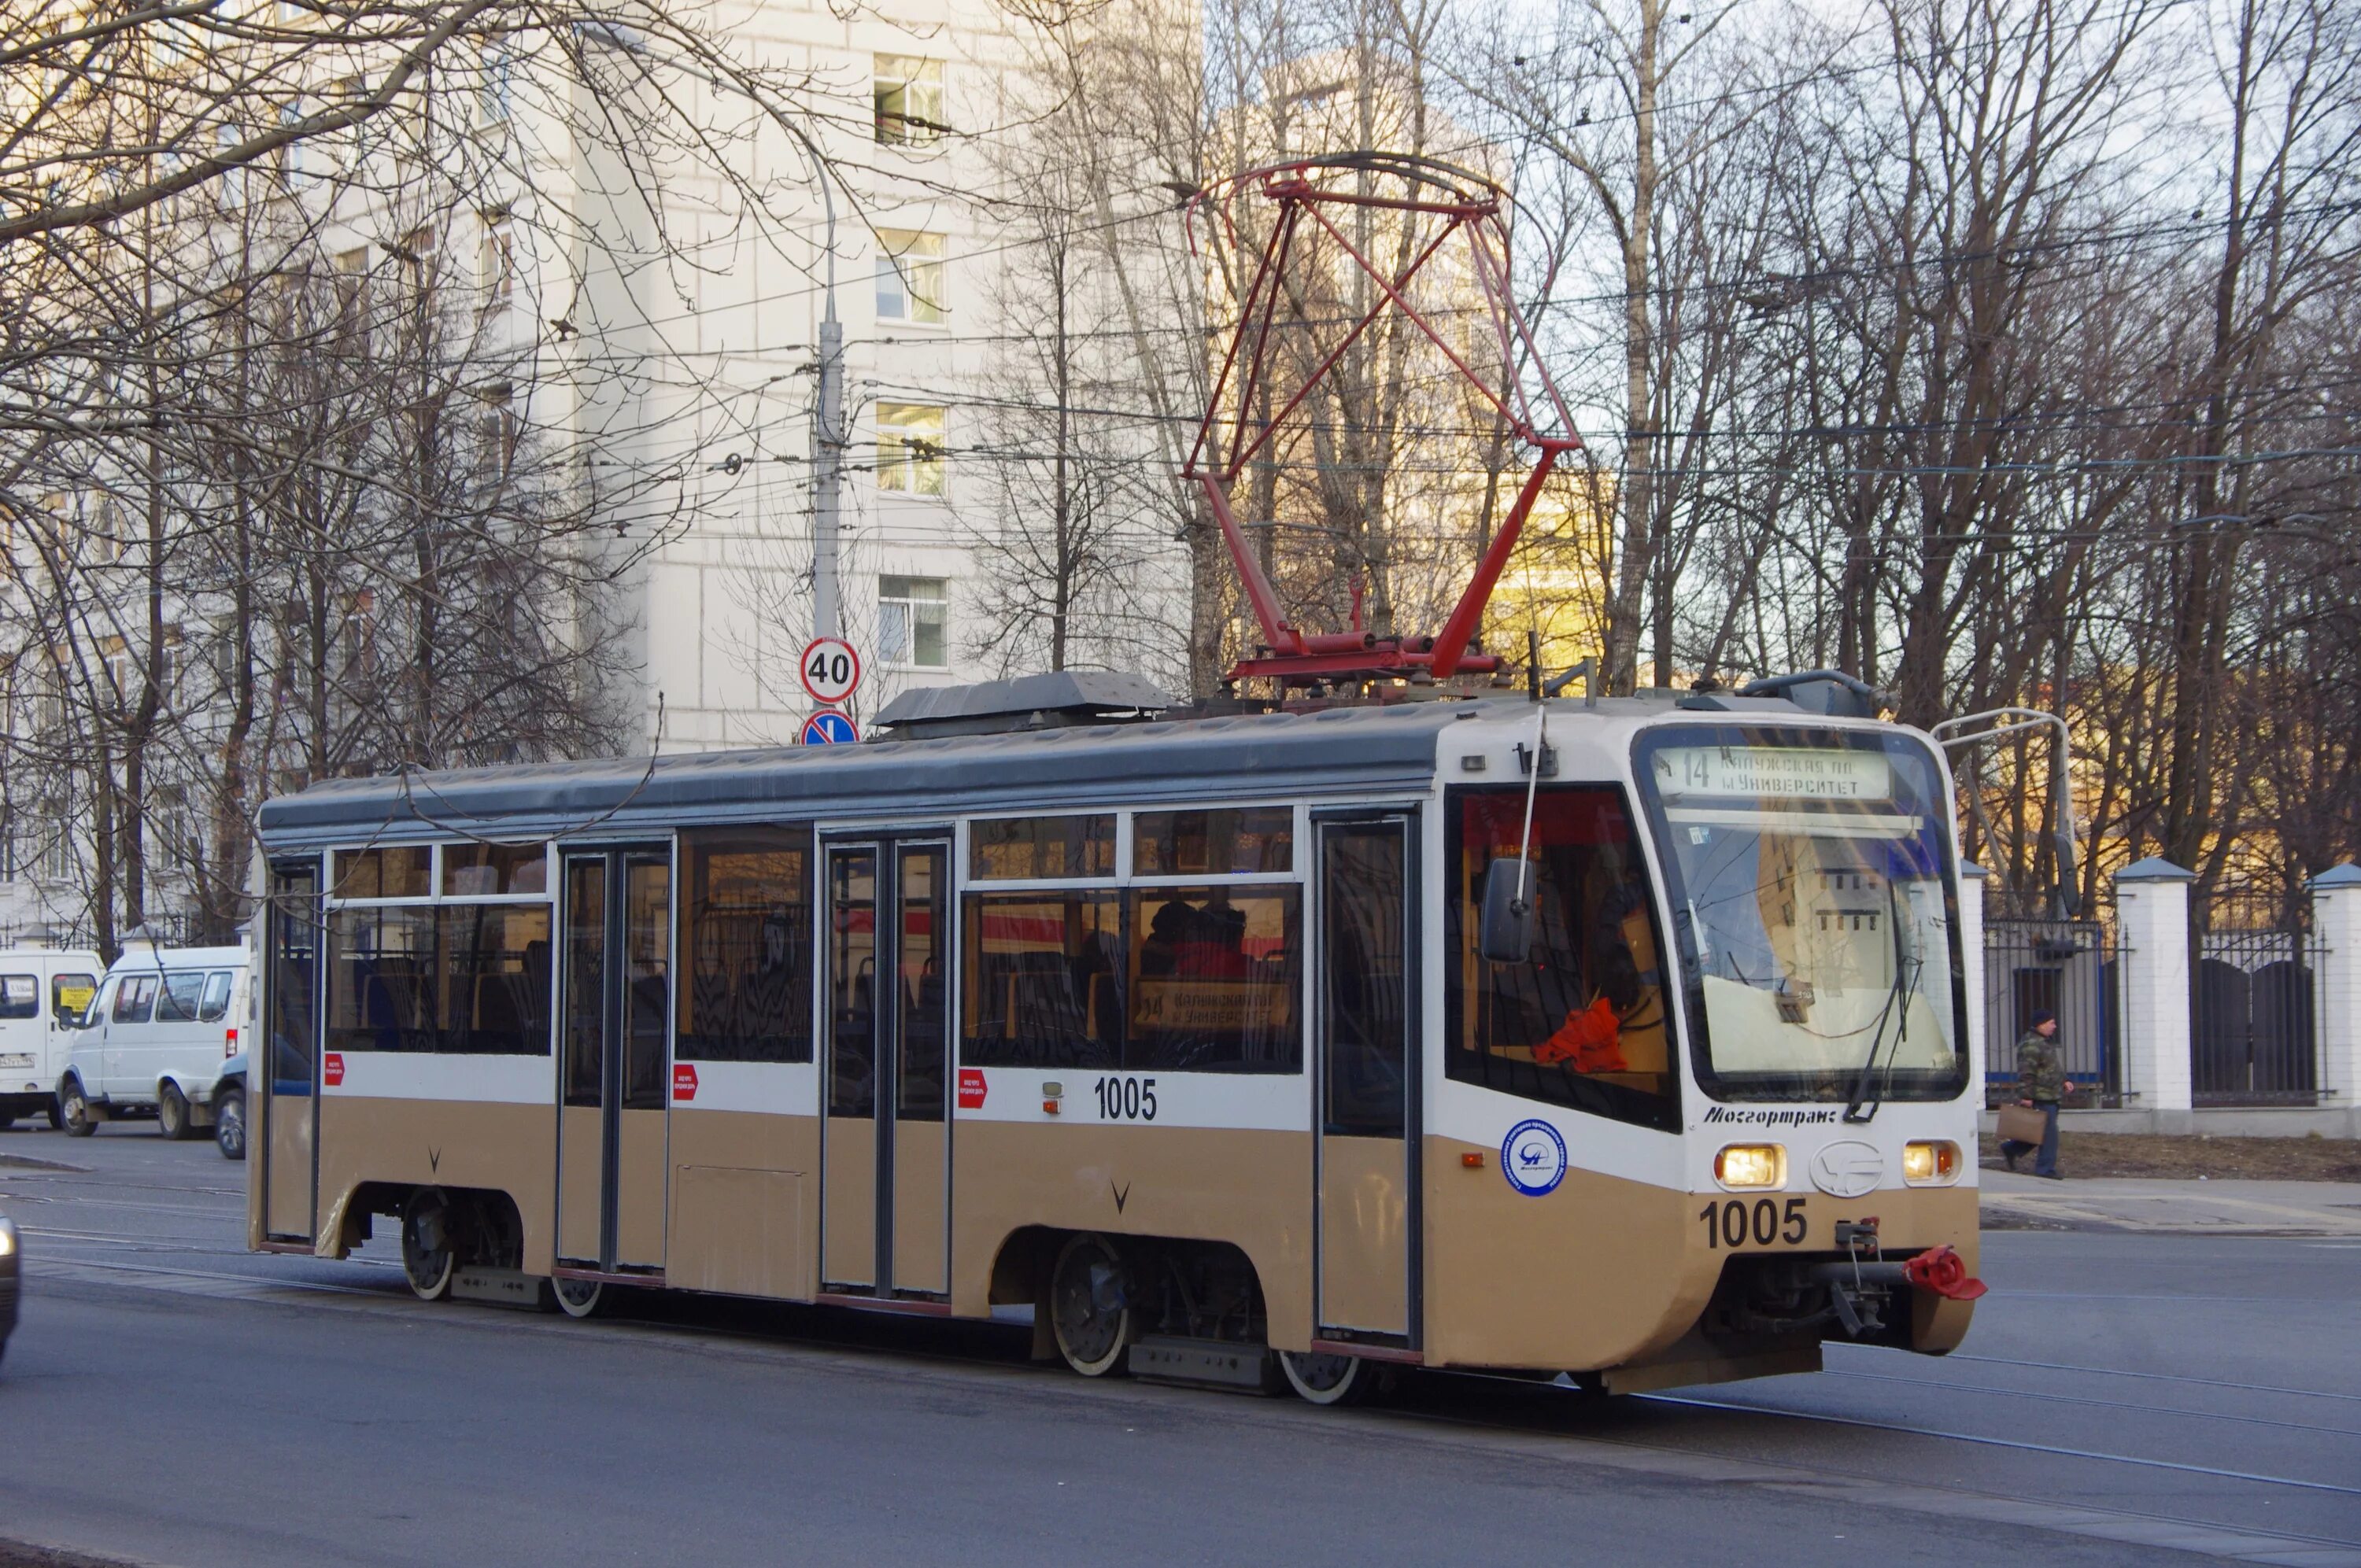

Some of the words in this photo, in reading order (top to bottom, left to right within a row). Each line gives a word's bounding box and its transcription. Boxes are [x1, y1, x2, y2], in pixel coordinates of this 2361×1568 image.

[808, 652, 849, 684] 40
[1683, 751, 1709, 788] 14
[1721, 755, 1823, 773] КАЛУЖСКАЯ
[1095, 1077, 1157, 1120] 1005
[1703, 1106, 1837, 1128] Мосгортранс
[1700, 1198, 1807, 1249] 1005
